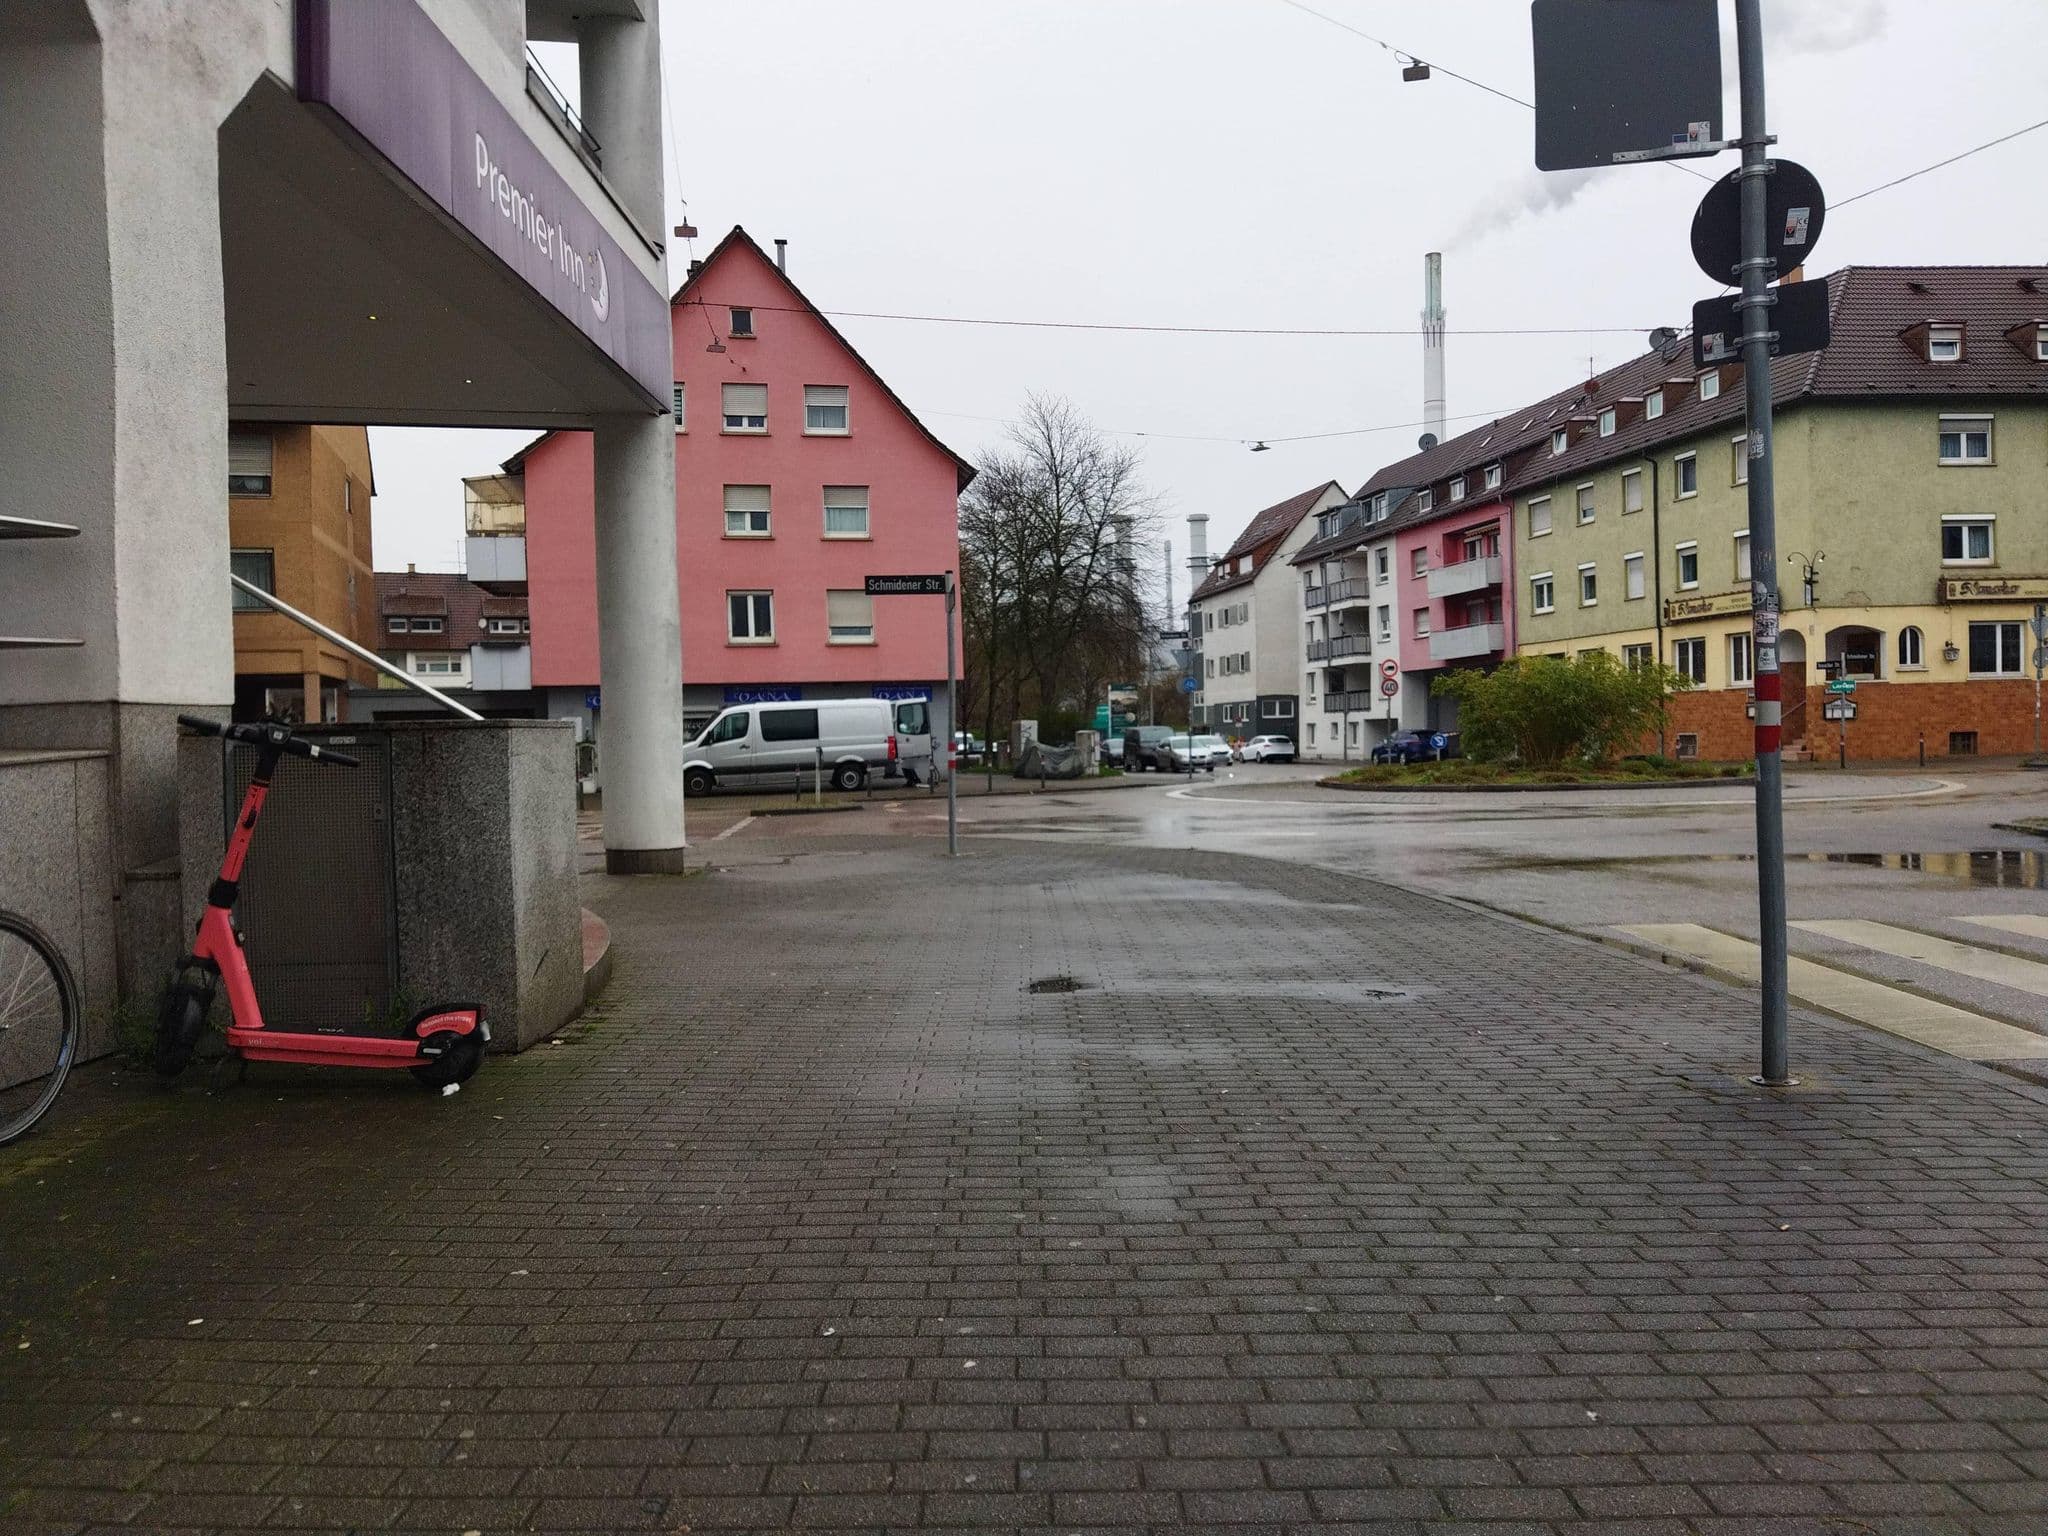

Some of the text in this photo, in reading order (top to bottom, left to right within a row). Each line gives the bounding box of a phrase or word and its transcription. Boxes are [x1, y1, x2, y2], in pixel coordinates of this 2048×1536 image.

[474, 130, 586, 293] Premier Inn
[868, 578, 942, 591] Schmidener Str.
[1385, 682, 1395, 692] 40
